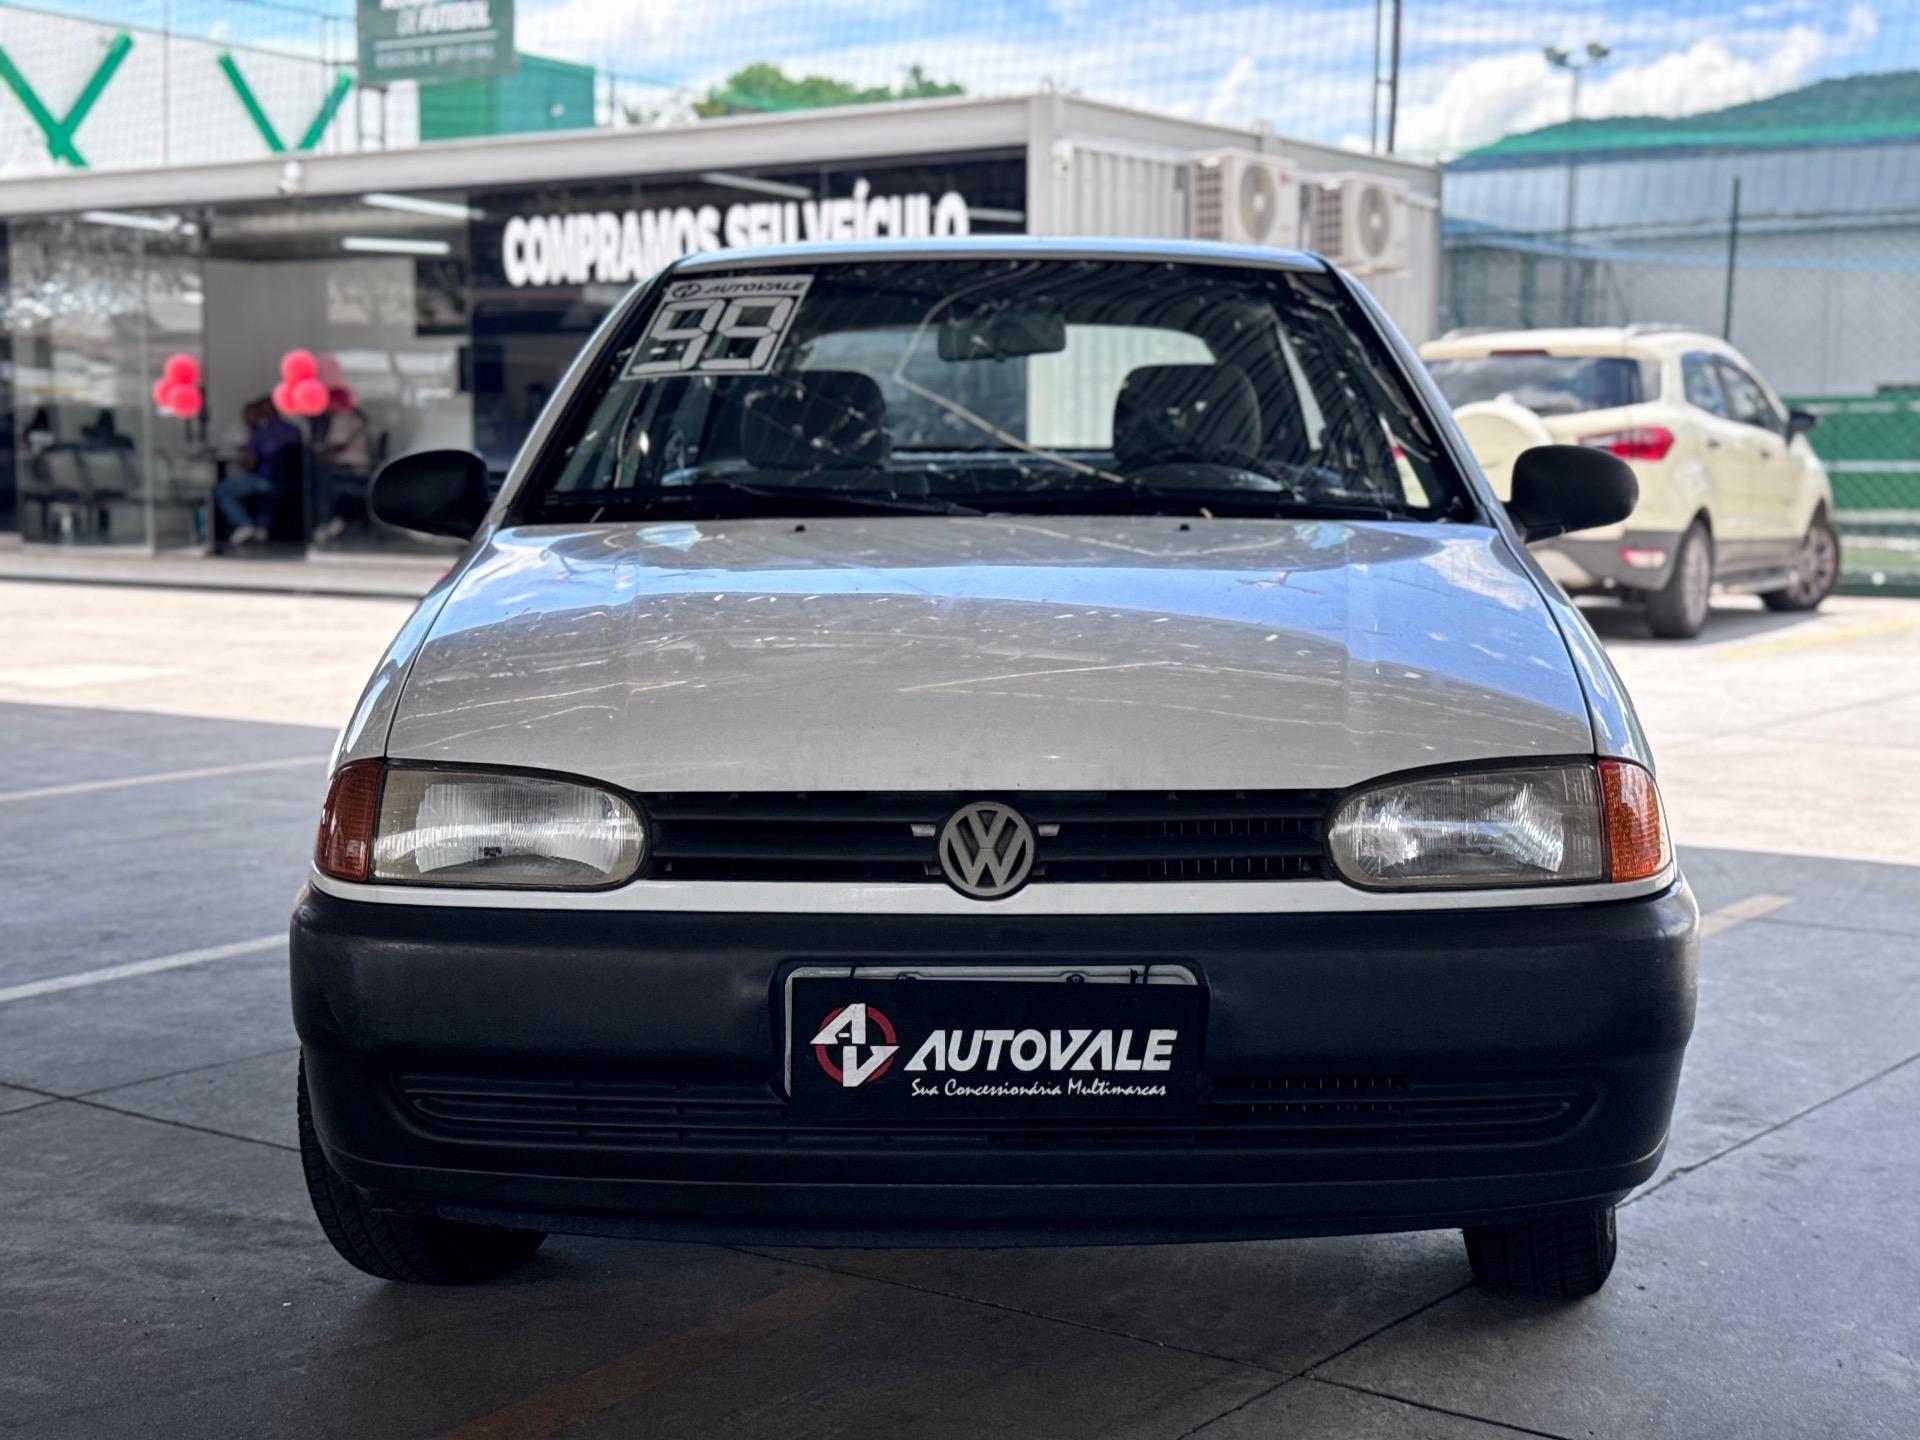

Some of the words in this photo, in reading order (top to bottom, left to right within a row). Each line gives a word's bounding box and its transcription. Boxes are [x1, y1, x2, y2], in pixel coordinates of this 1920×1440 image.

[503, 205, 722, 287] COMPRAMOS
[704, 280, 807, 295] AUTOVALE
[631, 298, 794, 375] 99
[903, 1028, 1178, 1072] AUTOVALE
[911, 1077, 940, 1097] Sua
[944, 1078, 1062, 1097] Concessionária
[1067, 1077, 1167, 1096] Multimarcas
